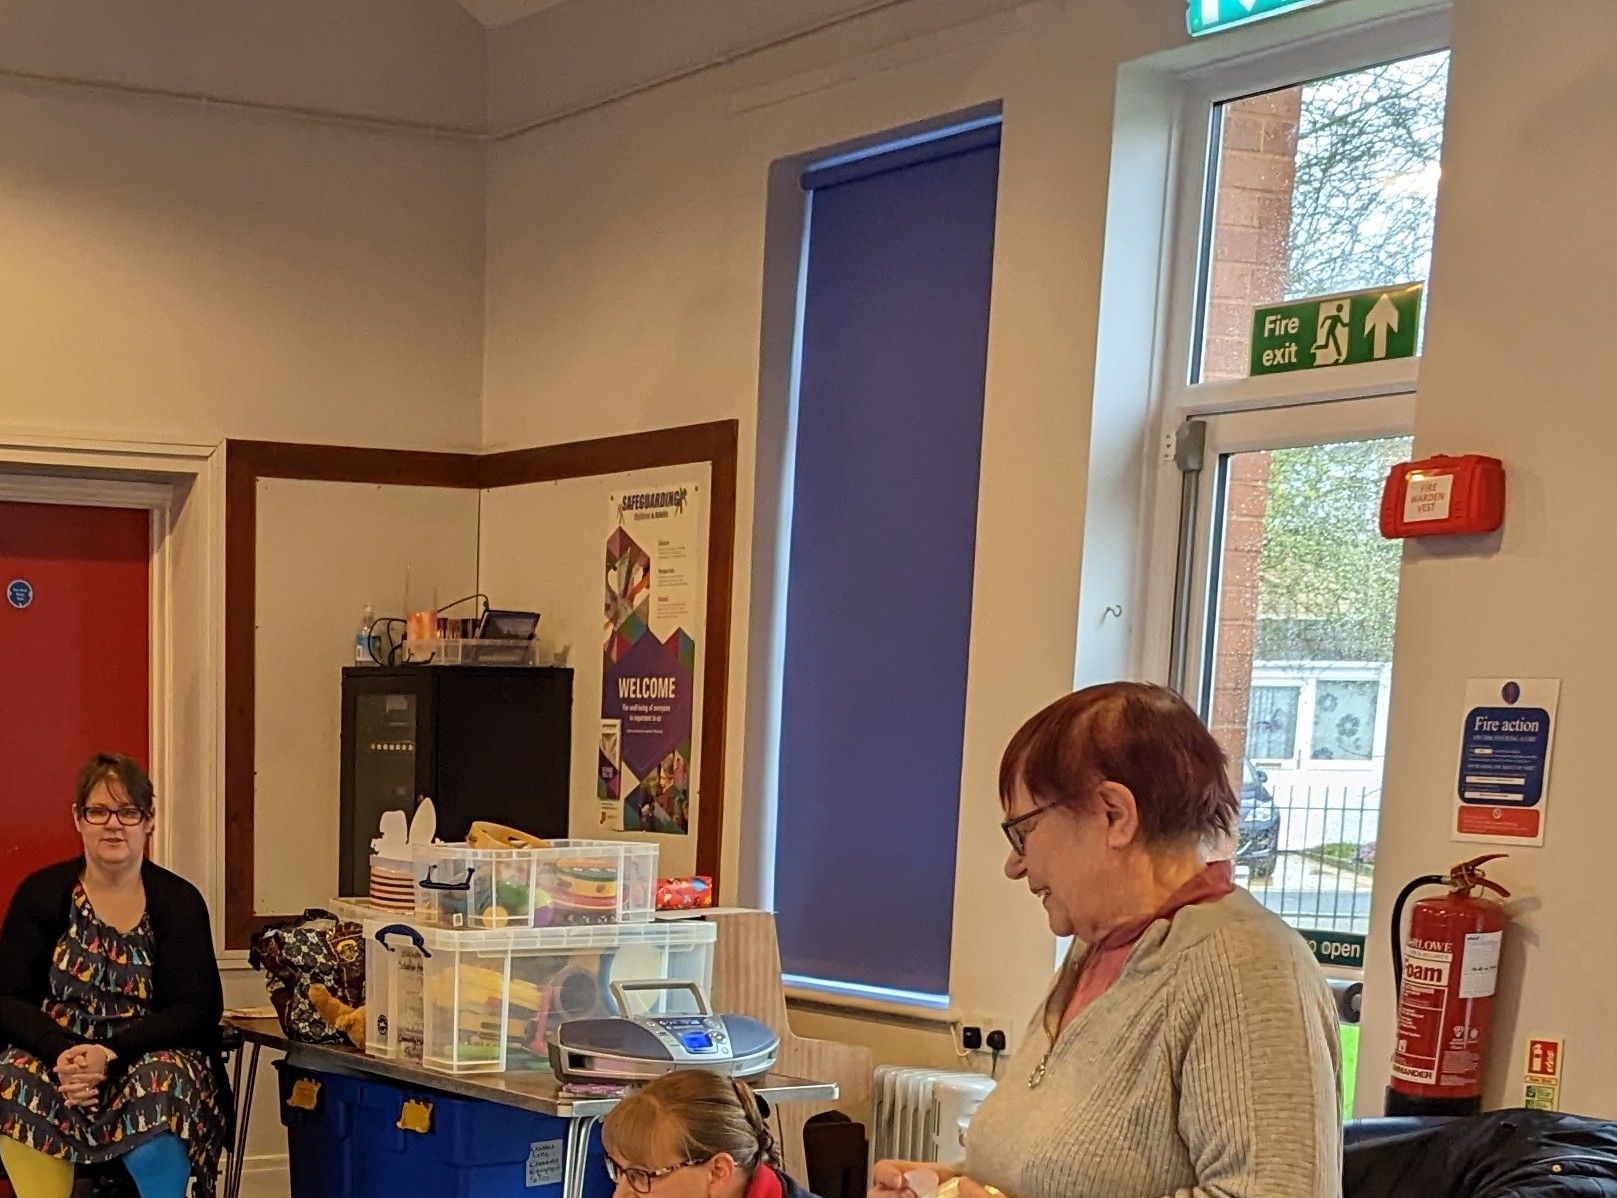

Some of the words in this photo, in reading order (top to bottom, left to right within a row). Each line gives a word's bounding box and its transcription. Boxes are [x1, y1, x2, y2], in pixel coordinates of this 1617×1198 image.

[1263, 314, 1299, 338] Fire
[1262, 341, 1298, 367] exit
[618, 677, 676, 699] WELCOME
[1474, 716, 1500, 731] Fire
[1501, 716, 1540, 733] action
[1321, 941, 1361, 960] open
[1405, 961, 1443, 983] oam
